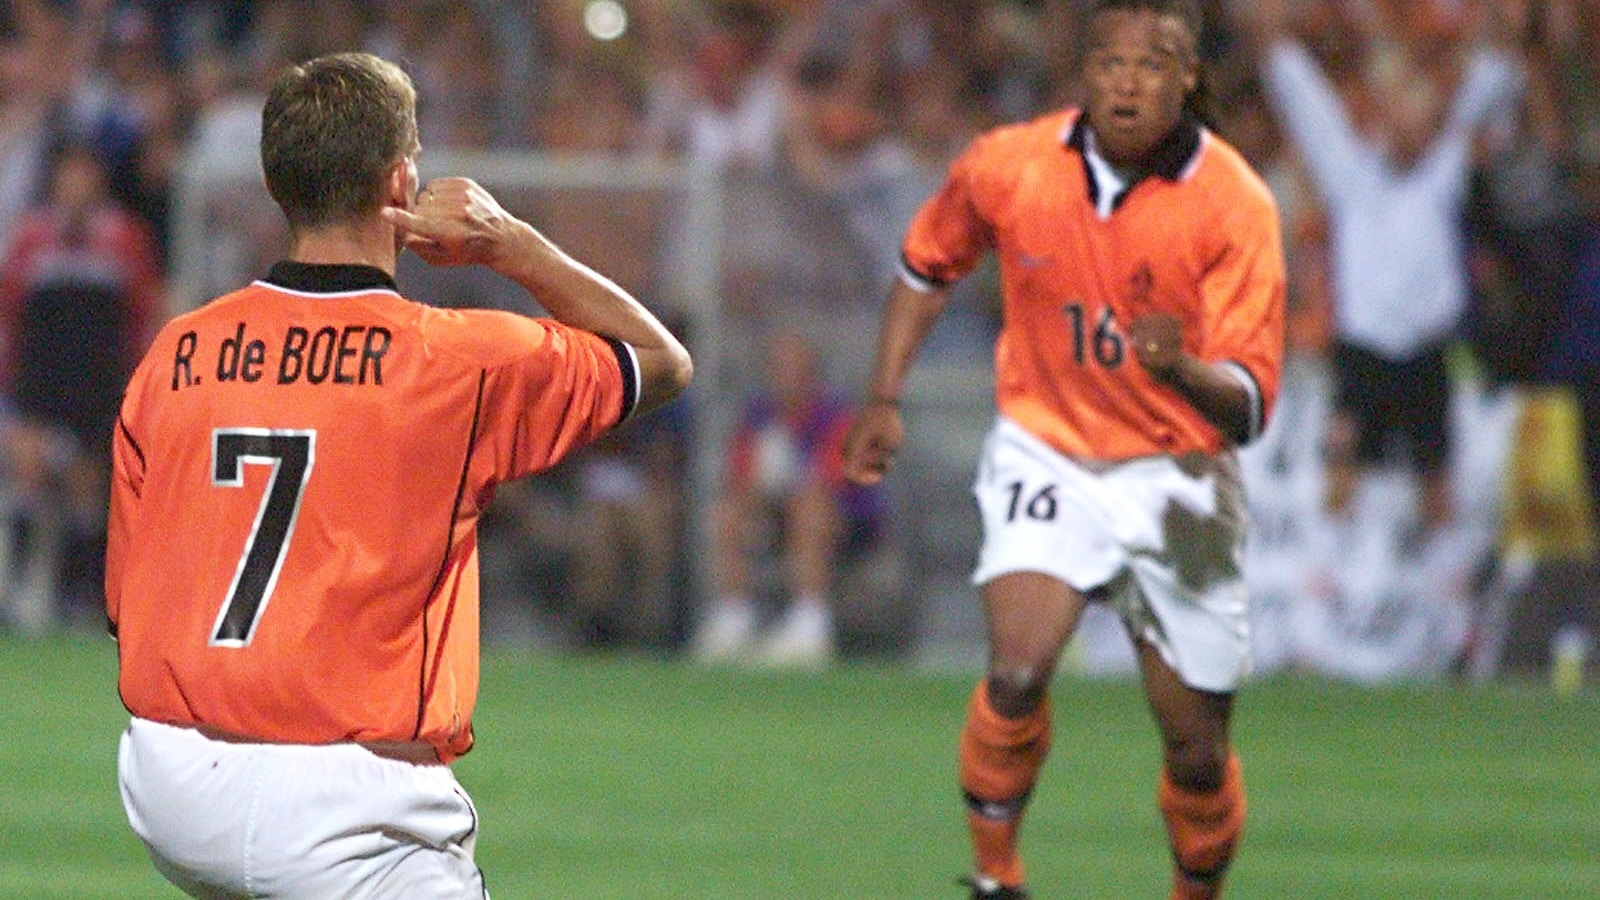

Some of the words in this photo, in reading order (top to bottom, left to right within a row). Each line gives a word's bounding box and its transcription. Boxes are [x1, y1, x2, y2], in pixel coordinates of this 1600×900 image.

[172, 331, 202, 391] R.
[216, 322, 266, 383] de
[277, 325, 392, 385] BOER
[1063, 304, 1123, 368] 16
[1006, 481, 1058, 522] 16
[208, 428, 316, 648] 7
